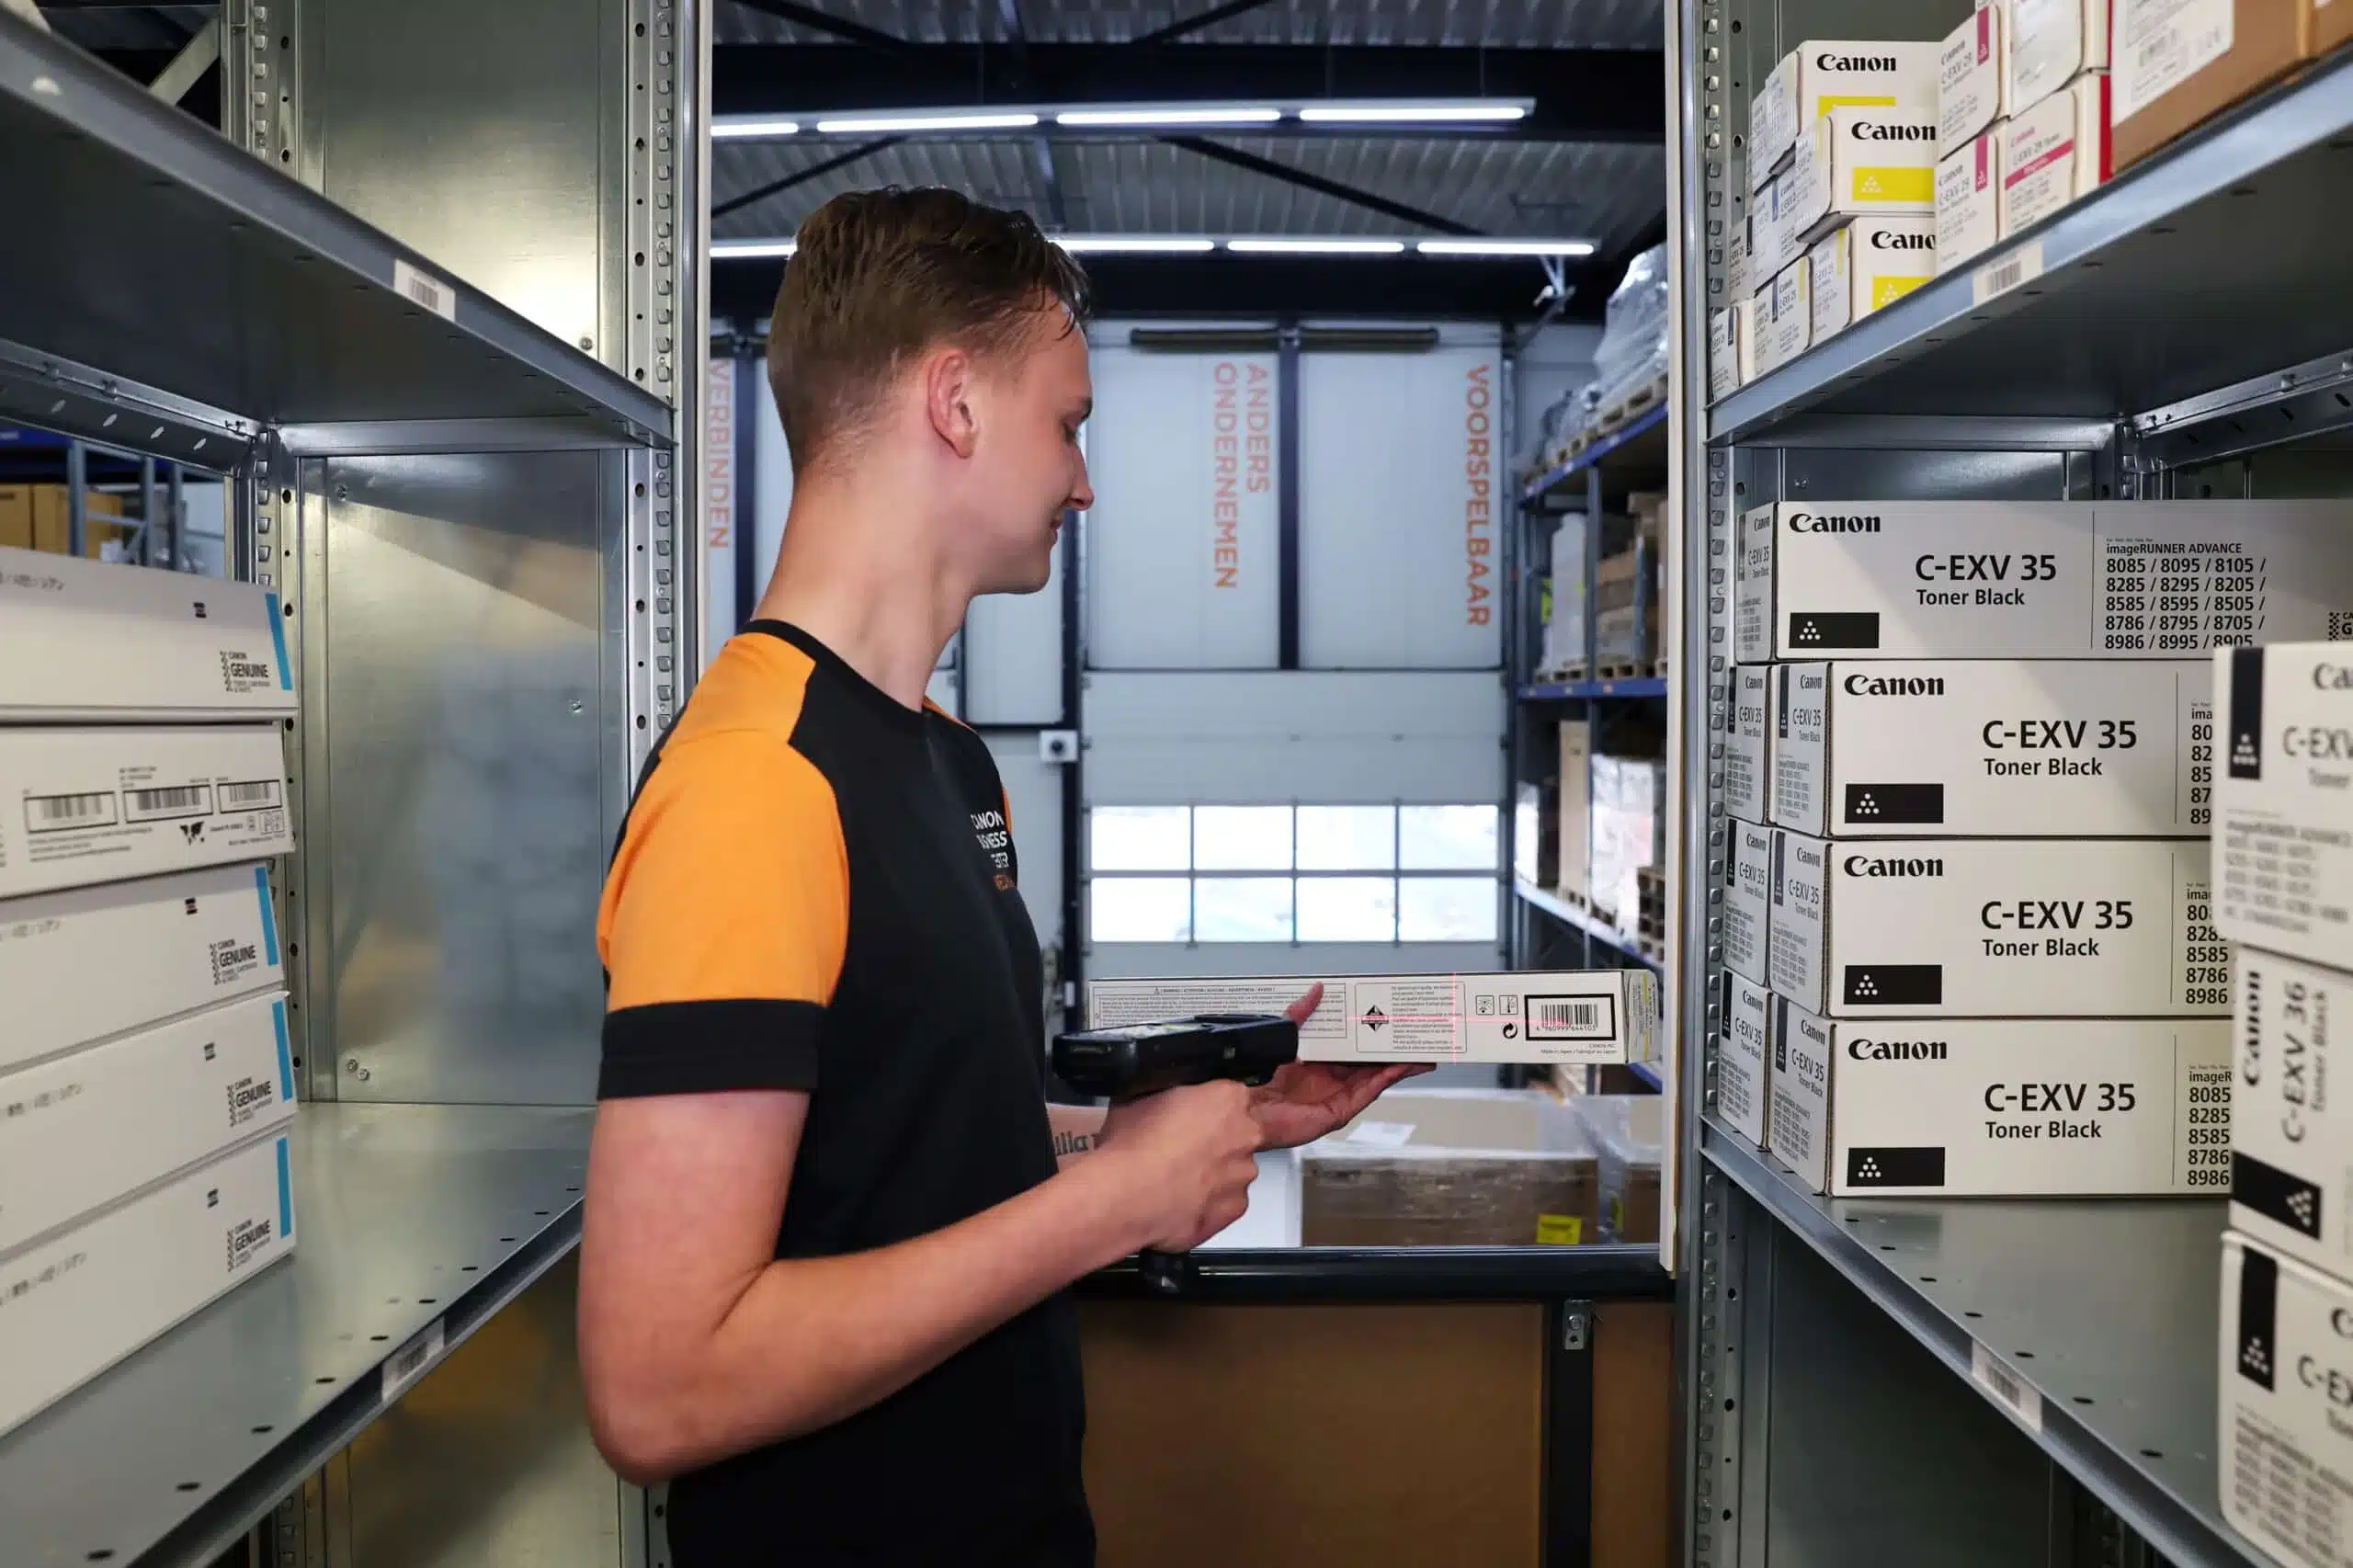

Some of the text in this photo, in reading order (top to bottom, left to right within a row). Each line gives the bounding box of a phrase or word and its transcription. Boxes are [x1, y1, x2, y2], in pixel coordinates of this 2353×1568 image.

[1816, 52, 1897, 73] Canon
[1851, 121, 1936, 142] Canon
[1246, 362, 1270, 494] ANDERS
[710, 359, 730, 548] VERBINDEN
[1213, 362, 1238, 589] ONDERNEMEN
[1466, 364, 1491, 626] VOORSPELBAAR
[1754, 515, 1770, 531] Canon
[1790, 513, 1881, 533] Canon
[2106, 543, 2243, 556] imageRUNNER ADVANCE
[1915, 554, 2057, 582] C-EXV 35
[2107, 558, 2146, 574] 8085
[2161, 558, 2200, 574] 8095
[2215, 558, 2254, 574] 8105
[2106, 577, 2145, 593] 8285
[2160, 577, 2200, 593] 8295
[2214, 577, 2254, 593] 8205
[1916, 588, 2025, 606] Toner Black
[2106, 597, 2144, 611] 8585
[2160, 597, 2199, 611] 8595
[2213, 597, 2254, 611] 8505
[2105, 615, 2144, 631] 8786
[2159, 615, 2199, 631] 8795
[2213, 615, 2253, 631] 8705
[2105, 634, 2144, 650] 8986
[2159, 634, 2199, 650] 8995
[230, 663, 269, 678] GENUINE
[1745, 676, 1763, 689] Canon
[1800, 674, 1823, 689] Canon
[1844, 674, 1944, 697] Canon
[1792, 709, 1822, 727] C-EXV 35
[1983, 720, 2137, 749] C-EXV 35
[1984, 757, 2102, 777] Toner Black
[1746, 833, 1767, 851] Canon
[1797, 846, 1821, 868] Canon
[1844, 856, 1944, 878] Canon
[1739, 861, 1765, 886] C-EXV 35
[1788, 879, 1819, 904] C-EXV 35
[1981, 902, 2133, 930] C-EXV 35
[2187, 926, 2227, 942] 828
[220, 945, 256, 968] GENUINE
[1982, 938, 2099, 958] Toner Black
[2187, 946, 2229, 963] 8585
[2186, 967, 2228, 983] 8786
[1743, 990, 1764, 1012] Canon
[2186, 988, 2228, 1005] 8986
[1735, 1017, 1762, 1046] C-EXV 35
[1801, 1018, 1825, 1045] Canon
[2243, 971, 2260, 1086] Canon
[1847, 1038, 1948, 1061] Canon
[1791, 1048, 1824, 1082] C-EXV 35
[2281, 981, 2307, 1142] C-EXV 36
[1798, 1073, 1824, 1098] Toner Black
[2189, 1087, 2232, 1103] 8085
[1984, 1084, 2136, 1112] C-EXV 35
[2189, 1108, 2231, 1124] 8285
[1985, 1120, 2102, 1140] Toner Black
[2188, 1129, 2230, 1144] 8585
[2188, 1149, 2230, 1165] 8786
[2188, 1170, 2230, 1186] 8986
